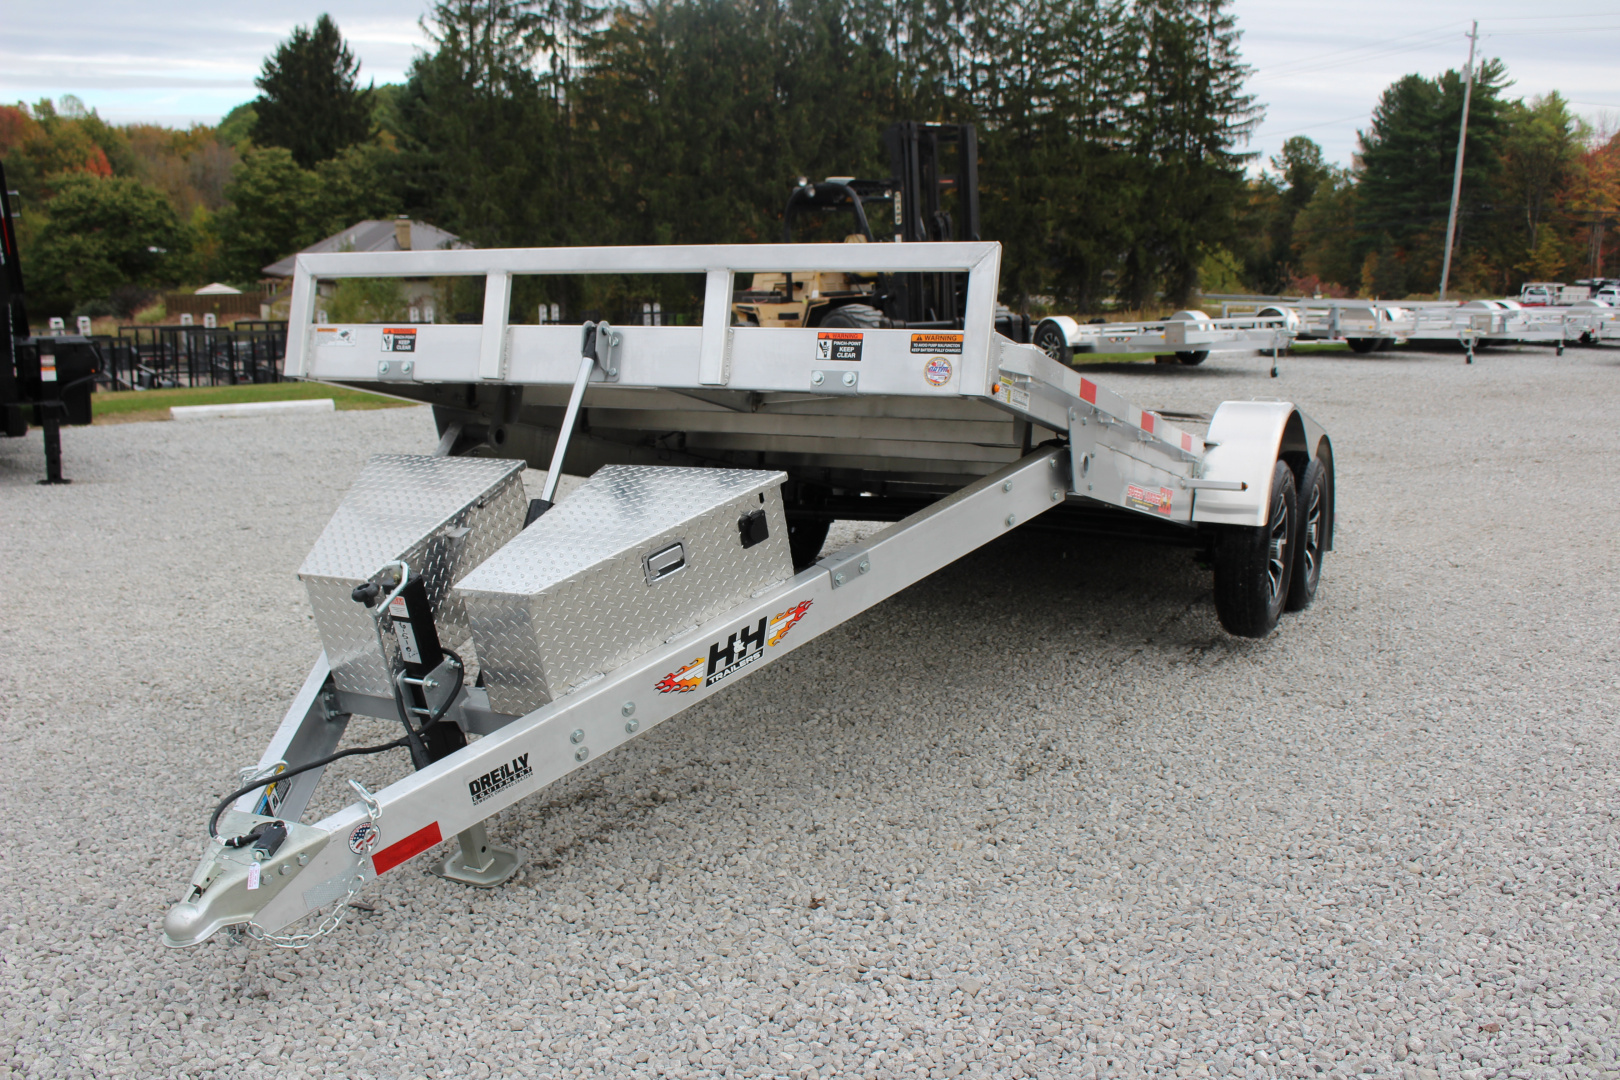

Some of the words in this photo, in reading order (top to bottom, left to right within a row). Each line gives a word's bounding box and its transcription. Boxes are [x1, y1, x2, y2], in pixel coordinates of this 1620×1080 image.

[1127, 484, 1144, 500] SPEED
[1143, 490, 1161, 506] LOADER
[706, 615, 768, 677] H&H
[708, 651, 762, 685] TRAILERS
[471, 766, 533, 803] EQUIPMENT
